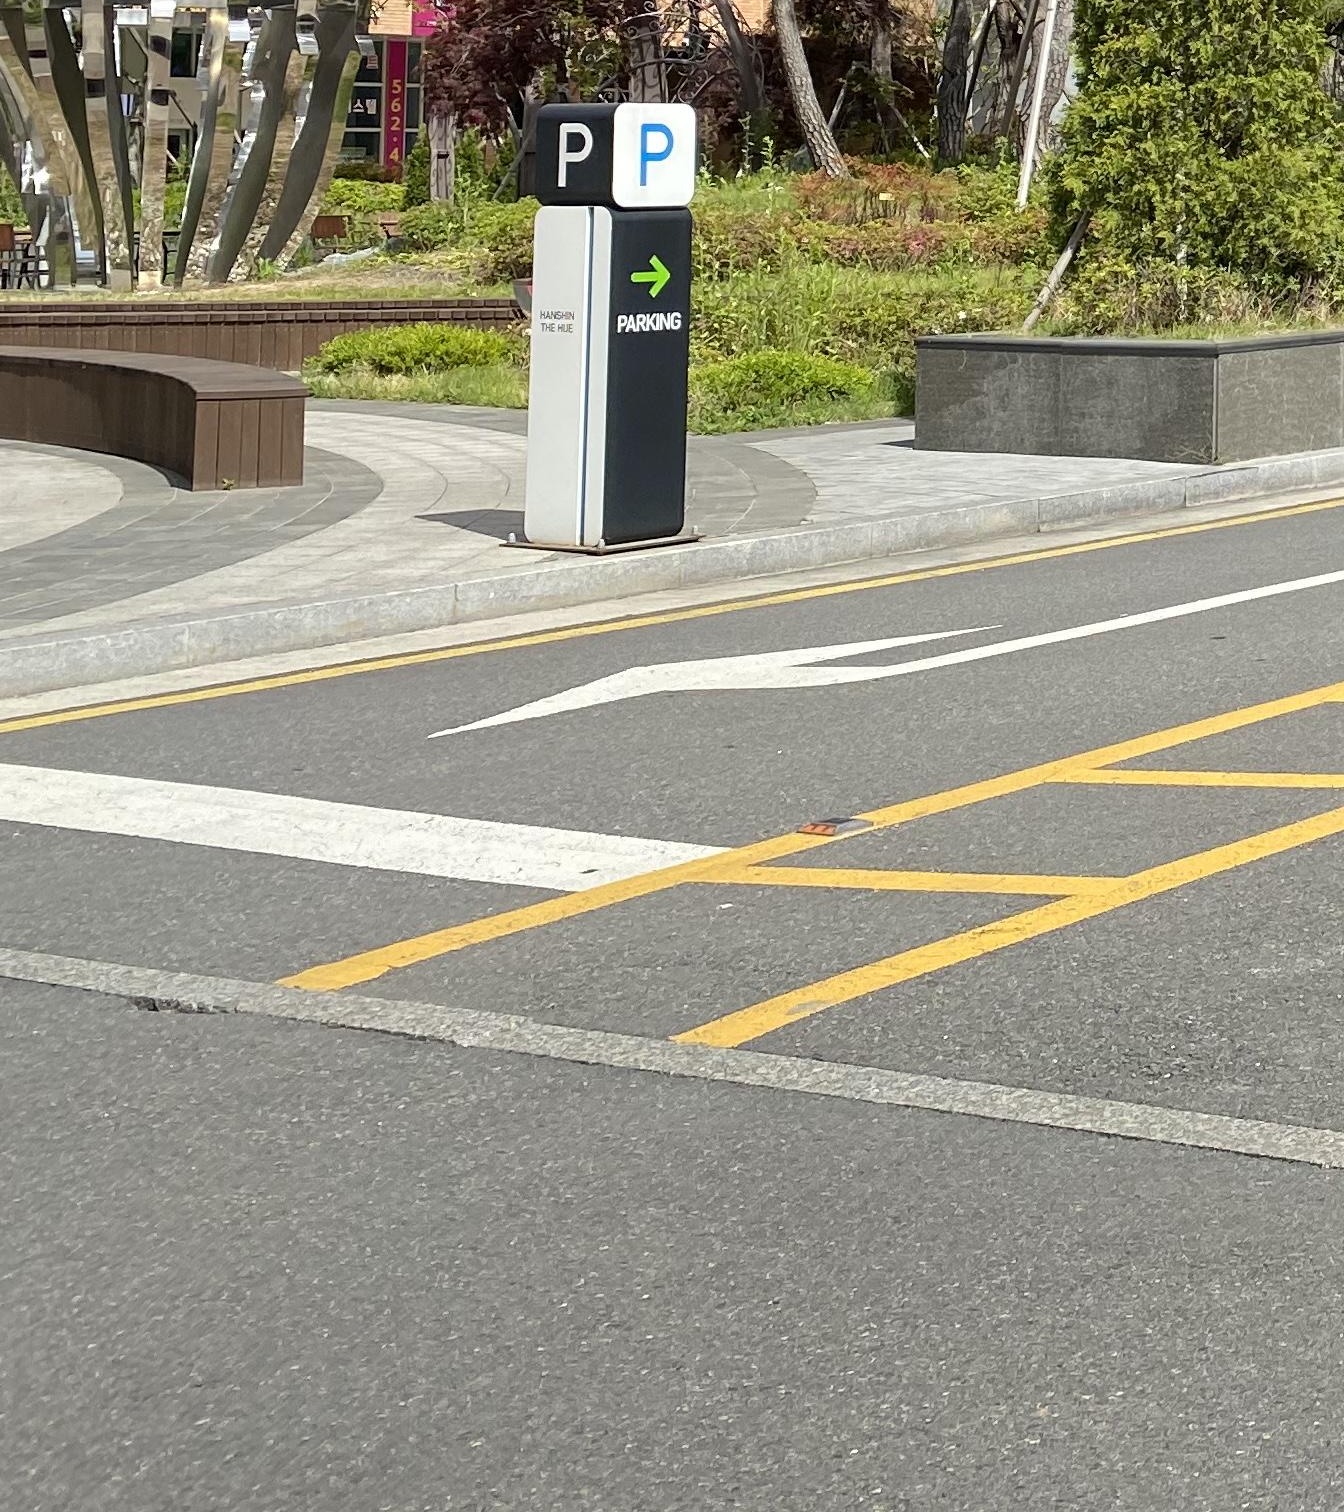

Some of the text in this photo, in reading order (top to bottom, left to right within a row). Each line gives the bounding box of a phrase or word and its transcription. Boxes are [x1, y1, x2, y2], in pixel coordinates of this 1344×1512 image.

[558, 122, 593, 188] P
[640, 123, 674, 186] P
[539, 310, 575, 321] HANSHIN
[617, 311, 682, 333] PARKING
[541, 322, 574, 333] THE HUE
